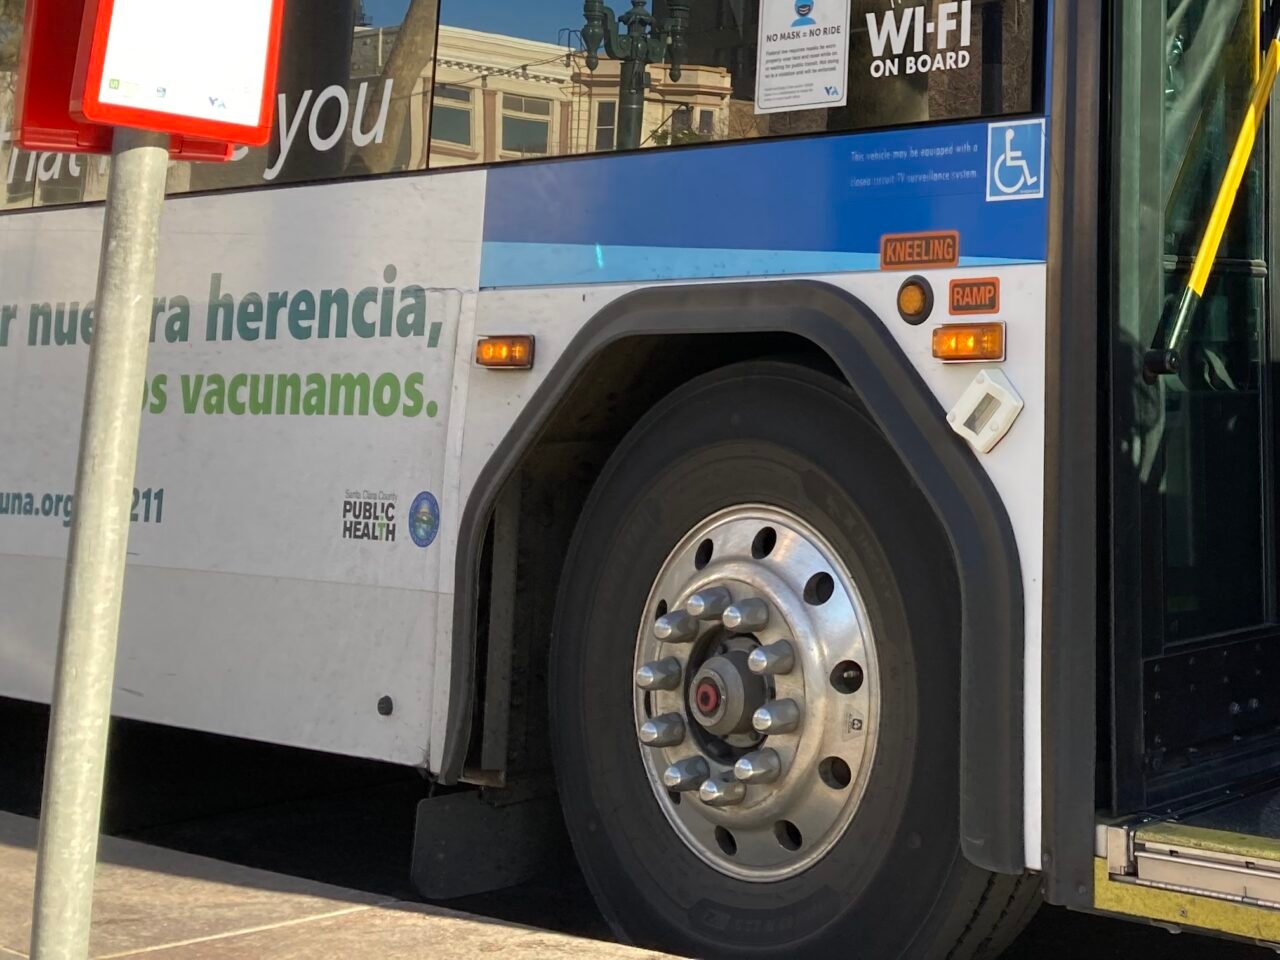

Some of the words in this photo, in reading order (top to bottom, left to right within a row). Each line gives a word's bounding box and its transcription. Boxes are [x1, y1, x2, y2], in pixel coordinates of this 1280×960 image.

[766, 33, 779, 43] NO
[779, 31, 801, 41] MASK
[809, 27, 822, 38] NO
[822, 25, 842, 35] RIDE
[865, 0, 972, 57] WI-FI
[870, 57, 899, 78] ON
[904, 50, 971, 75] BOARD
[263, 78, 394, 181] you
[885, 237, 953, 263] KNEELING
[206, 263, 444, 348] herencia,
[952, 285, 995, 308] RAMP
[180, 371, 439, 418] vacunamos.
[342, 500, 396, 522] PUBLIC
[342, 521, 396, 542] HEALTH
